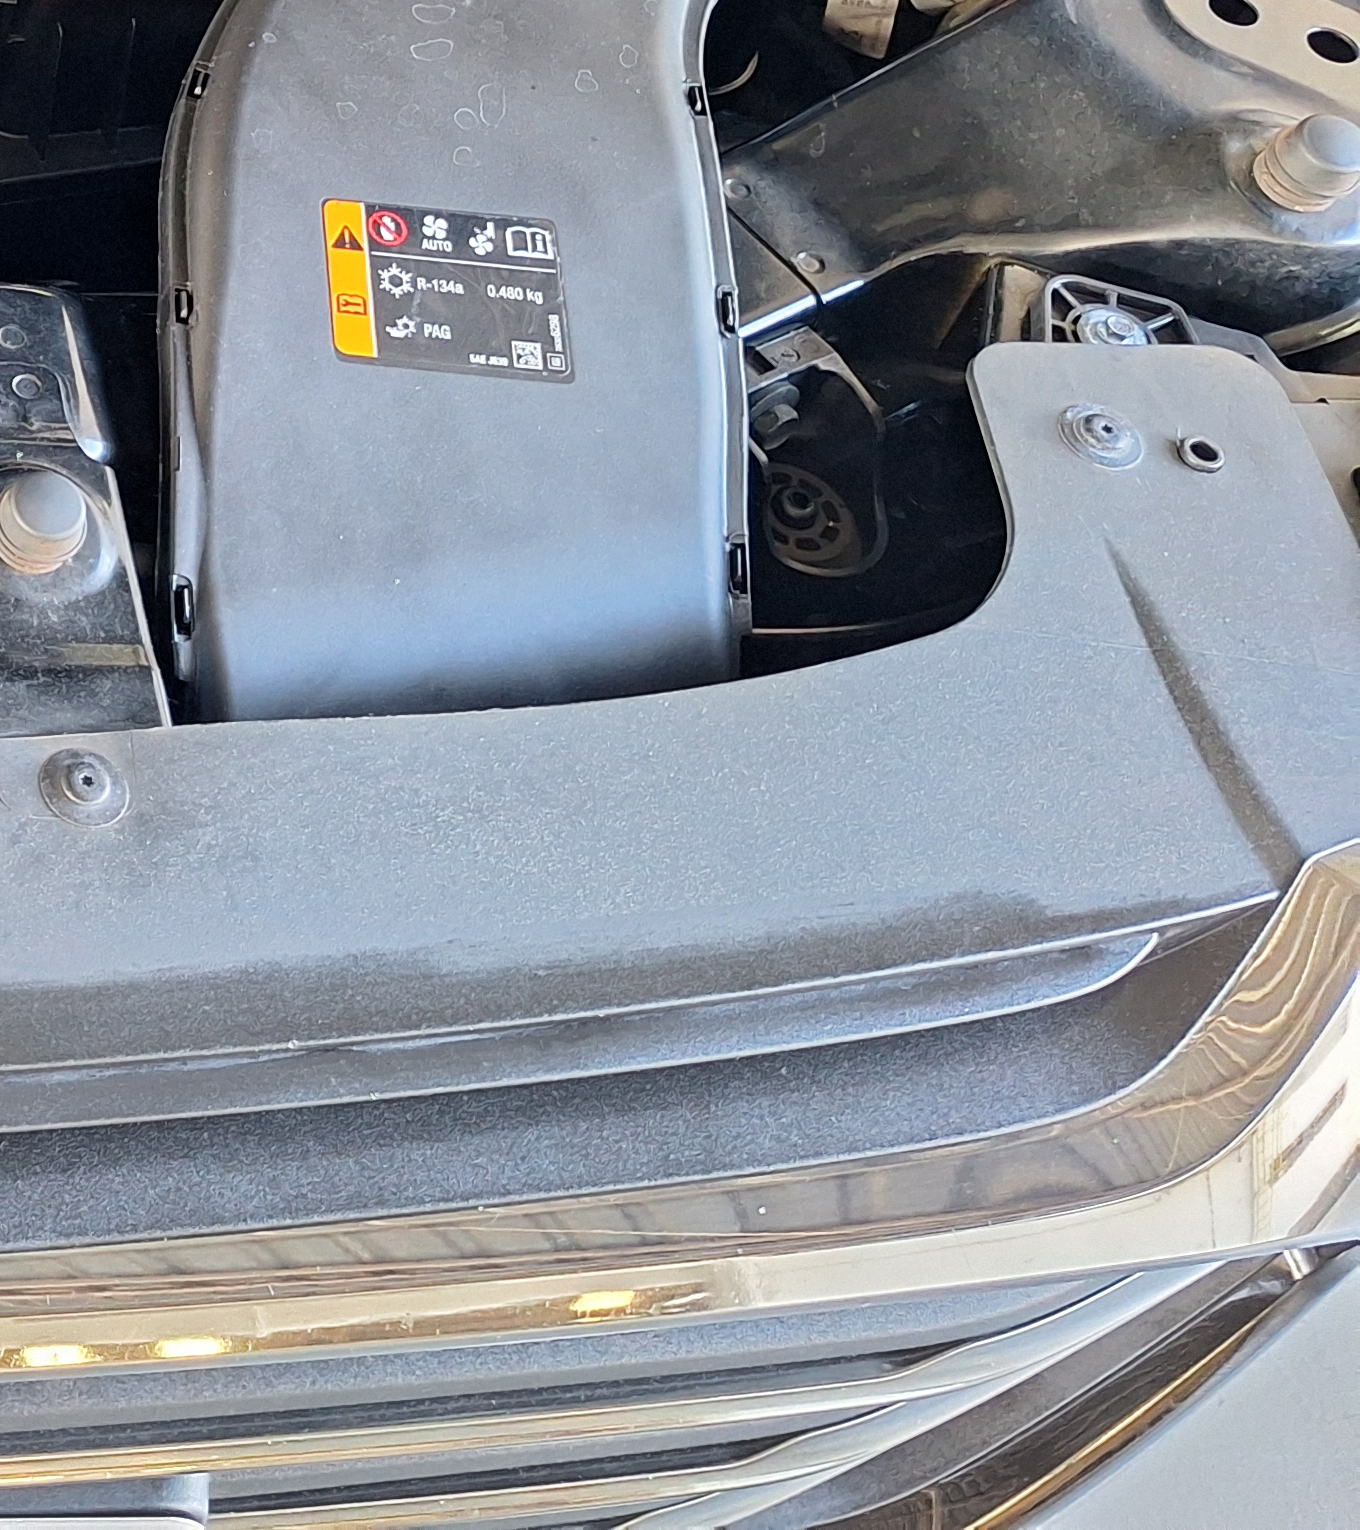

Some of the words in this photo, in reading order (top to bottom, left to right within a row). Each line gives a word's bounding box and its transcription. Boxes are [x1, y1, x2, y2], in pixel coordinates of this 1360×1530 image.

[421, 238, 453, 253] AUTO
[416, 277, 465, 295] R-134a
[486, 284, 524, 301] 0.480
[525, 287, 544, 305] kg
[423, 323, 452, 340] PAG
